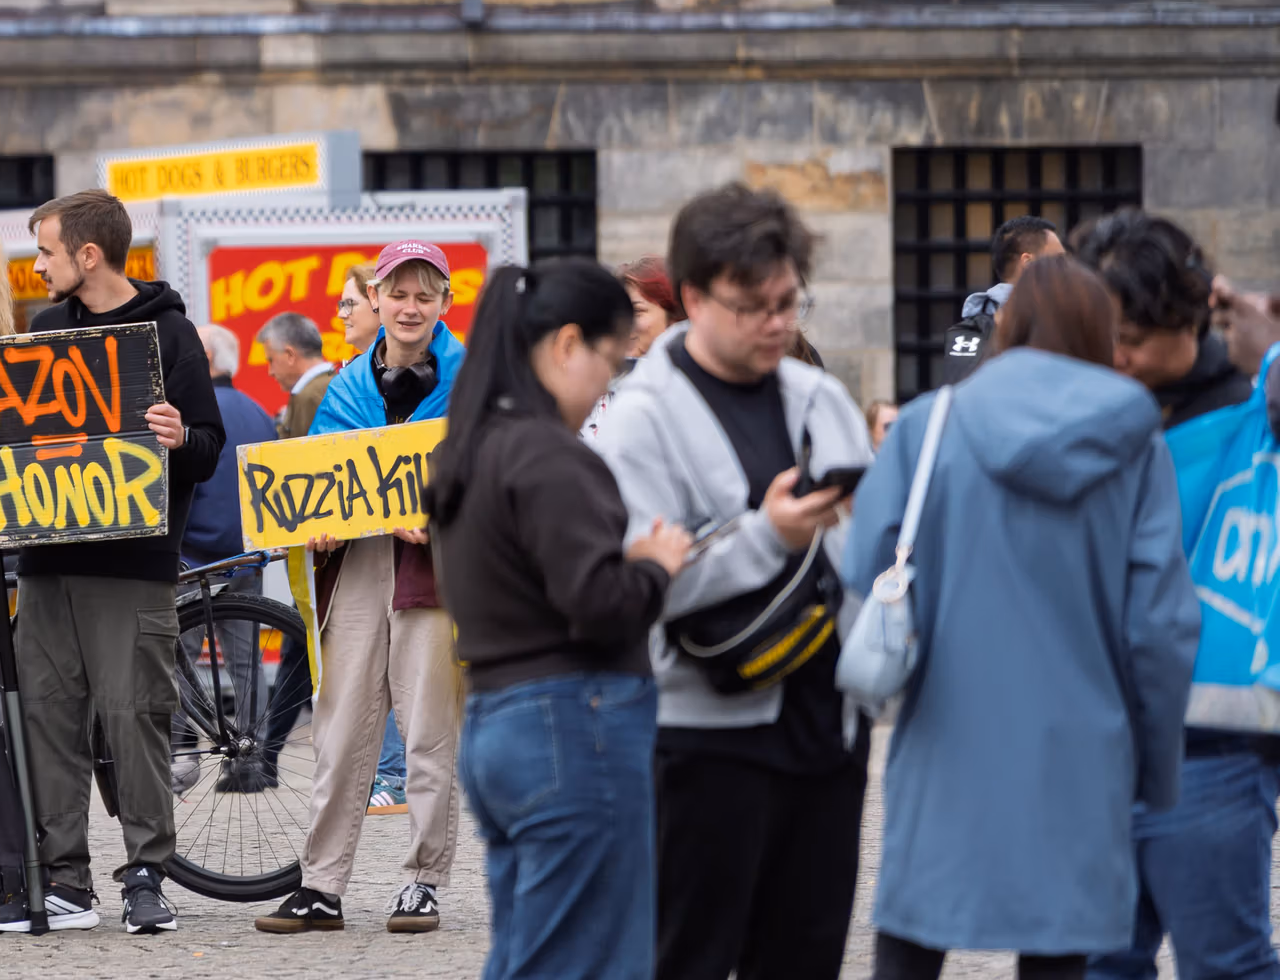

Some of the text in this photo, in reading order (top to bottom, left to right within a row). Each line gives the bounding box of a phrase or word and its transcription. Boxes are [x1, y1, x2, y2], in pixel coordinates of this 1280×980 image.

[157, 162, 202, 190] DOGS
[234, 152, 311, 185] BURGERS
[401, 247, 425, 255] CLUB
[210, 253, 321, 323] HOT
[325, 250, 486, 306] DS
